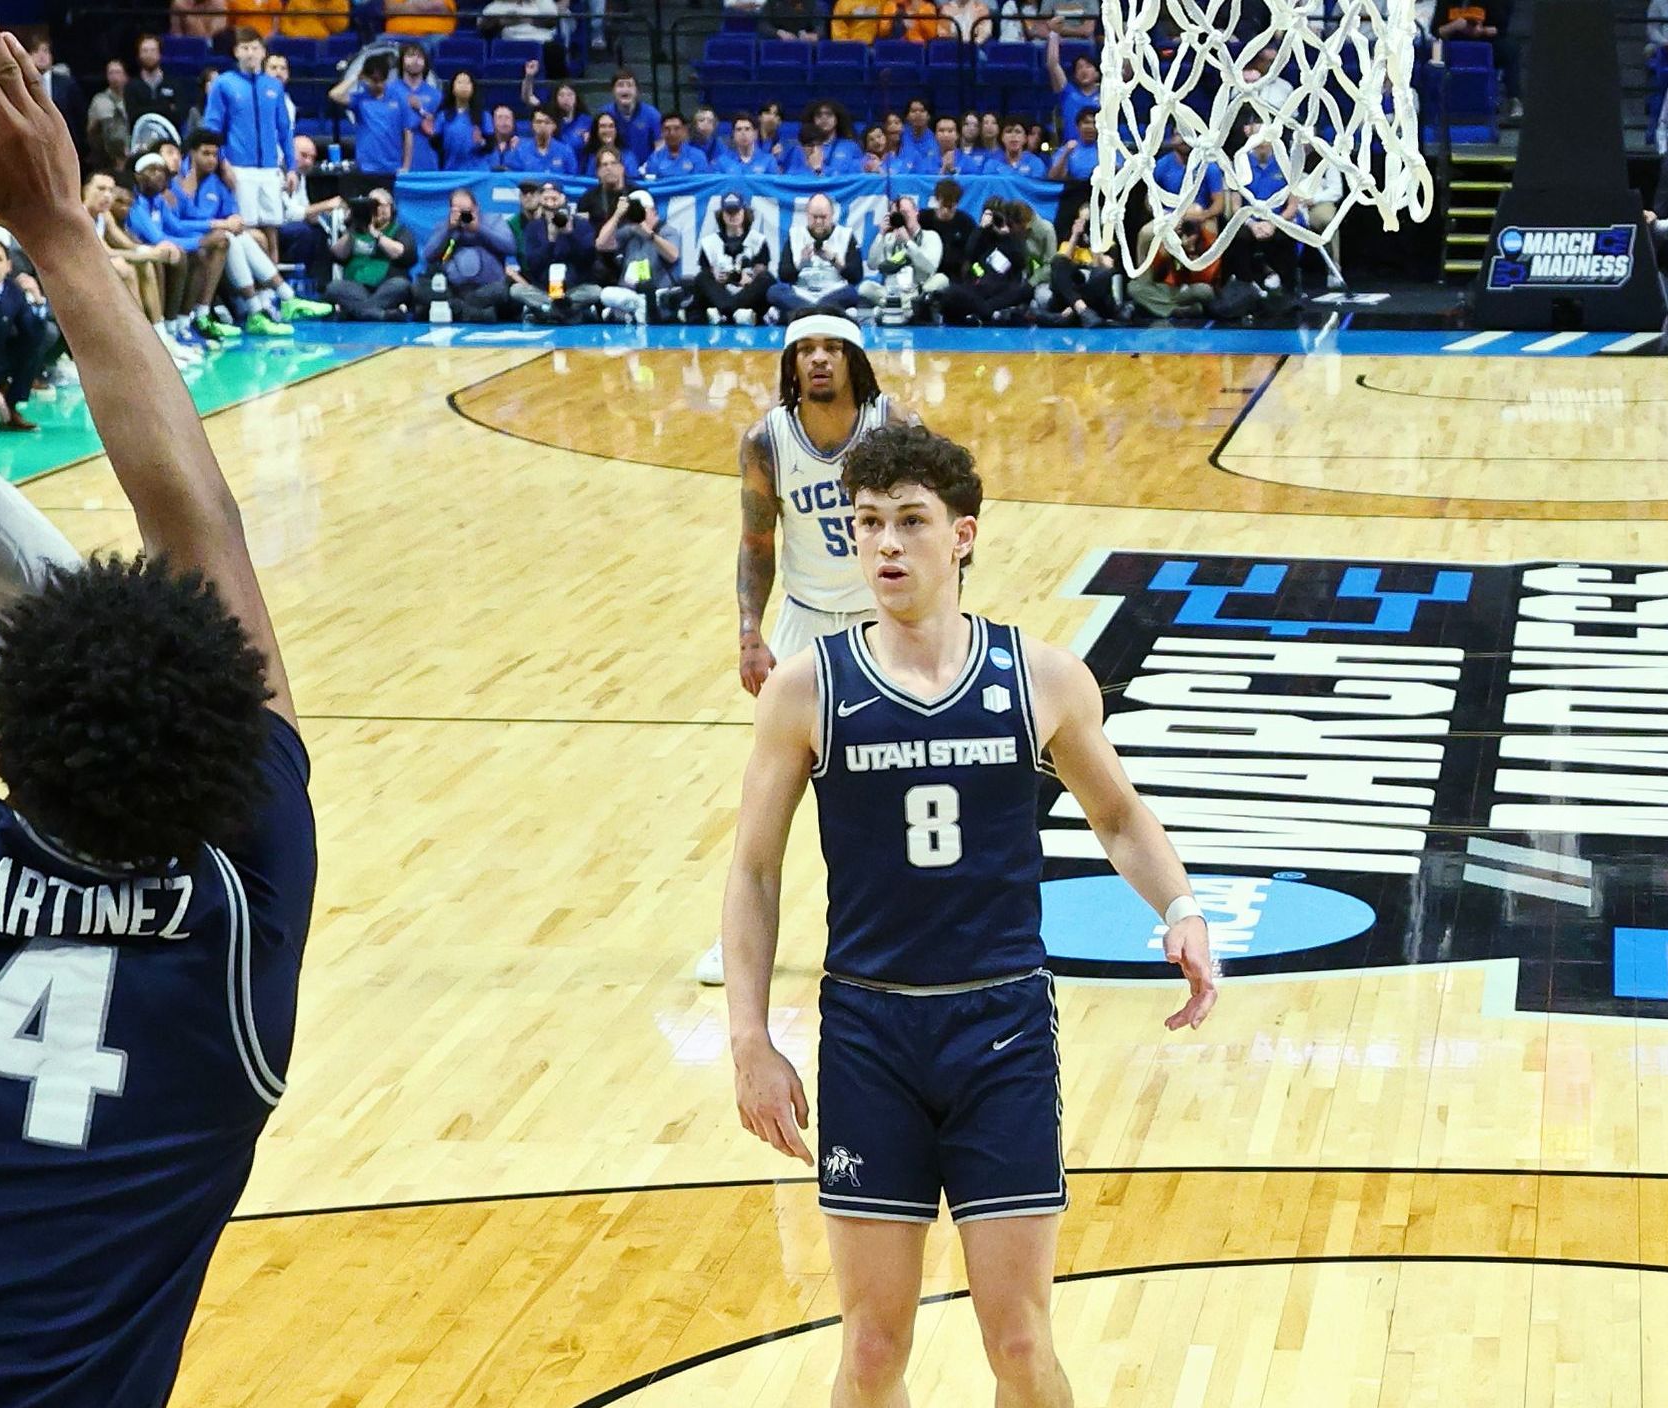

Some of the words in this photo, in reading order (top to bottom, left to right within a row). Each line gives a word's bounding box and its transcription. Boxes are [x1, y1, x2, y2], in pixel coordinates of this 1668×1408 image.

[1522, 231, 1596, 255] MARCH
[1530, 254, 1630, 277] MADNESS
[790, 479, 852, 514] UCL
[845, 740, 930, 772] UTAH
[930, 737, 1017, 766] STATE
[1038, 636, 1466, 874] MARCH
[904, 783, 963, 868] 8
